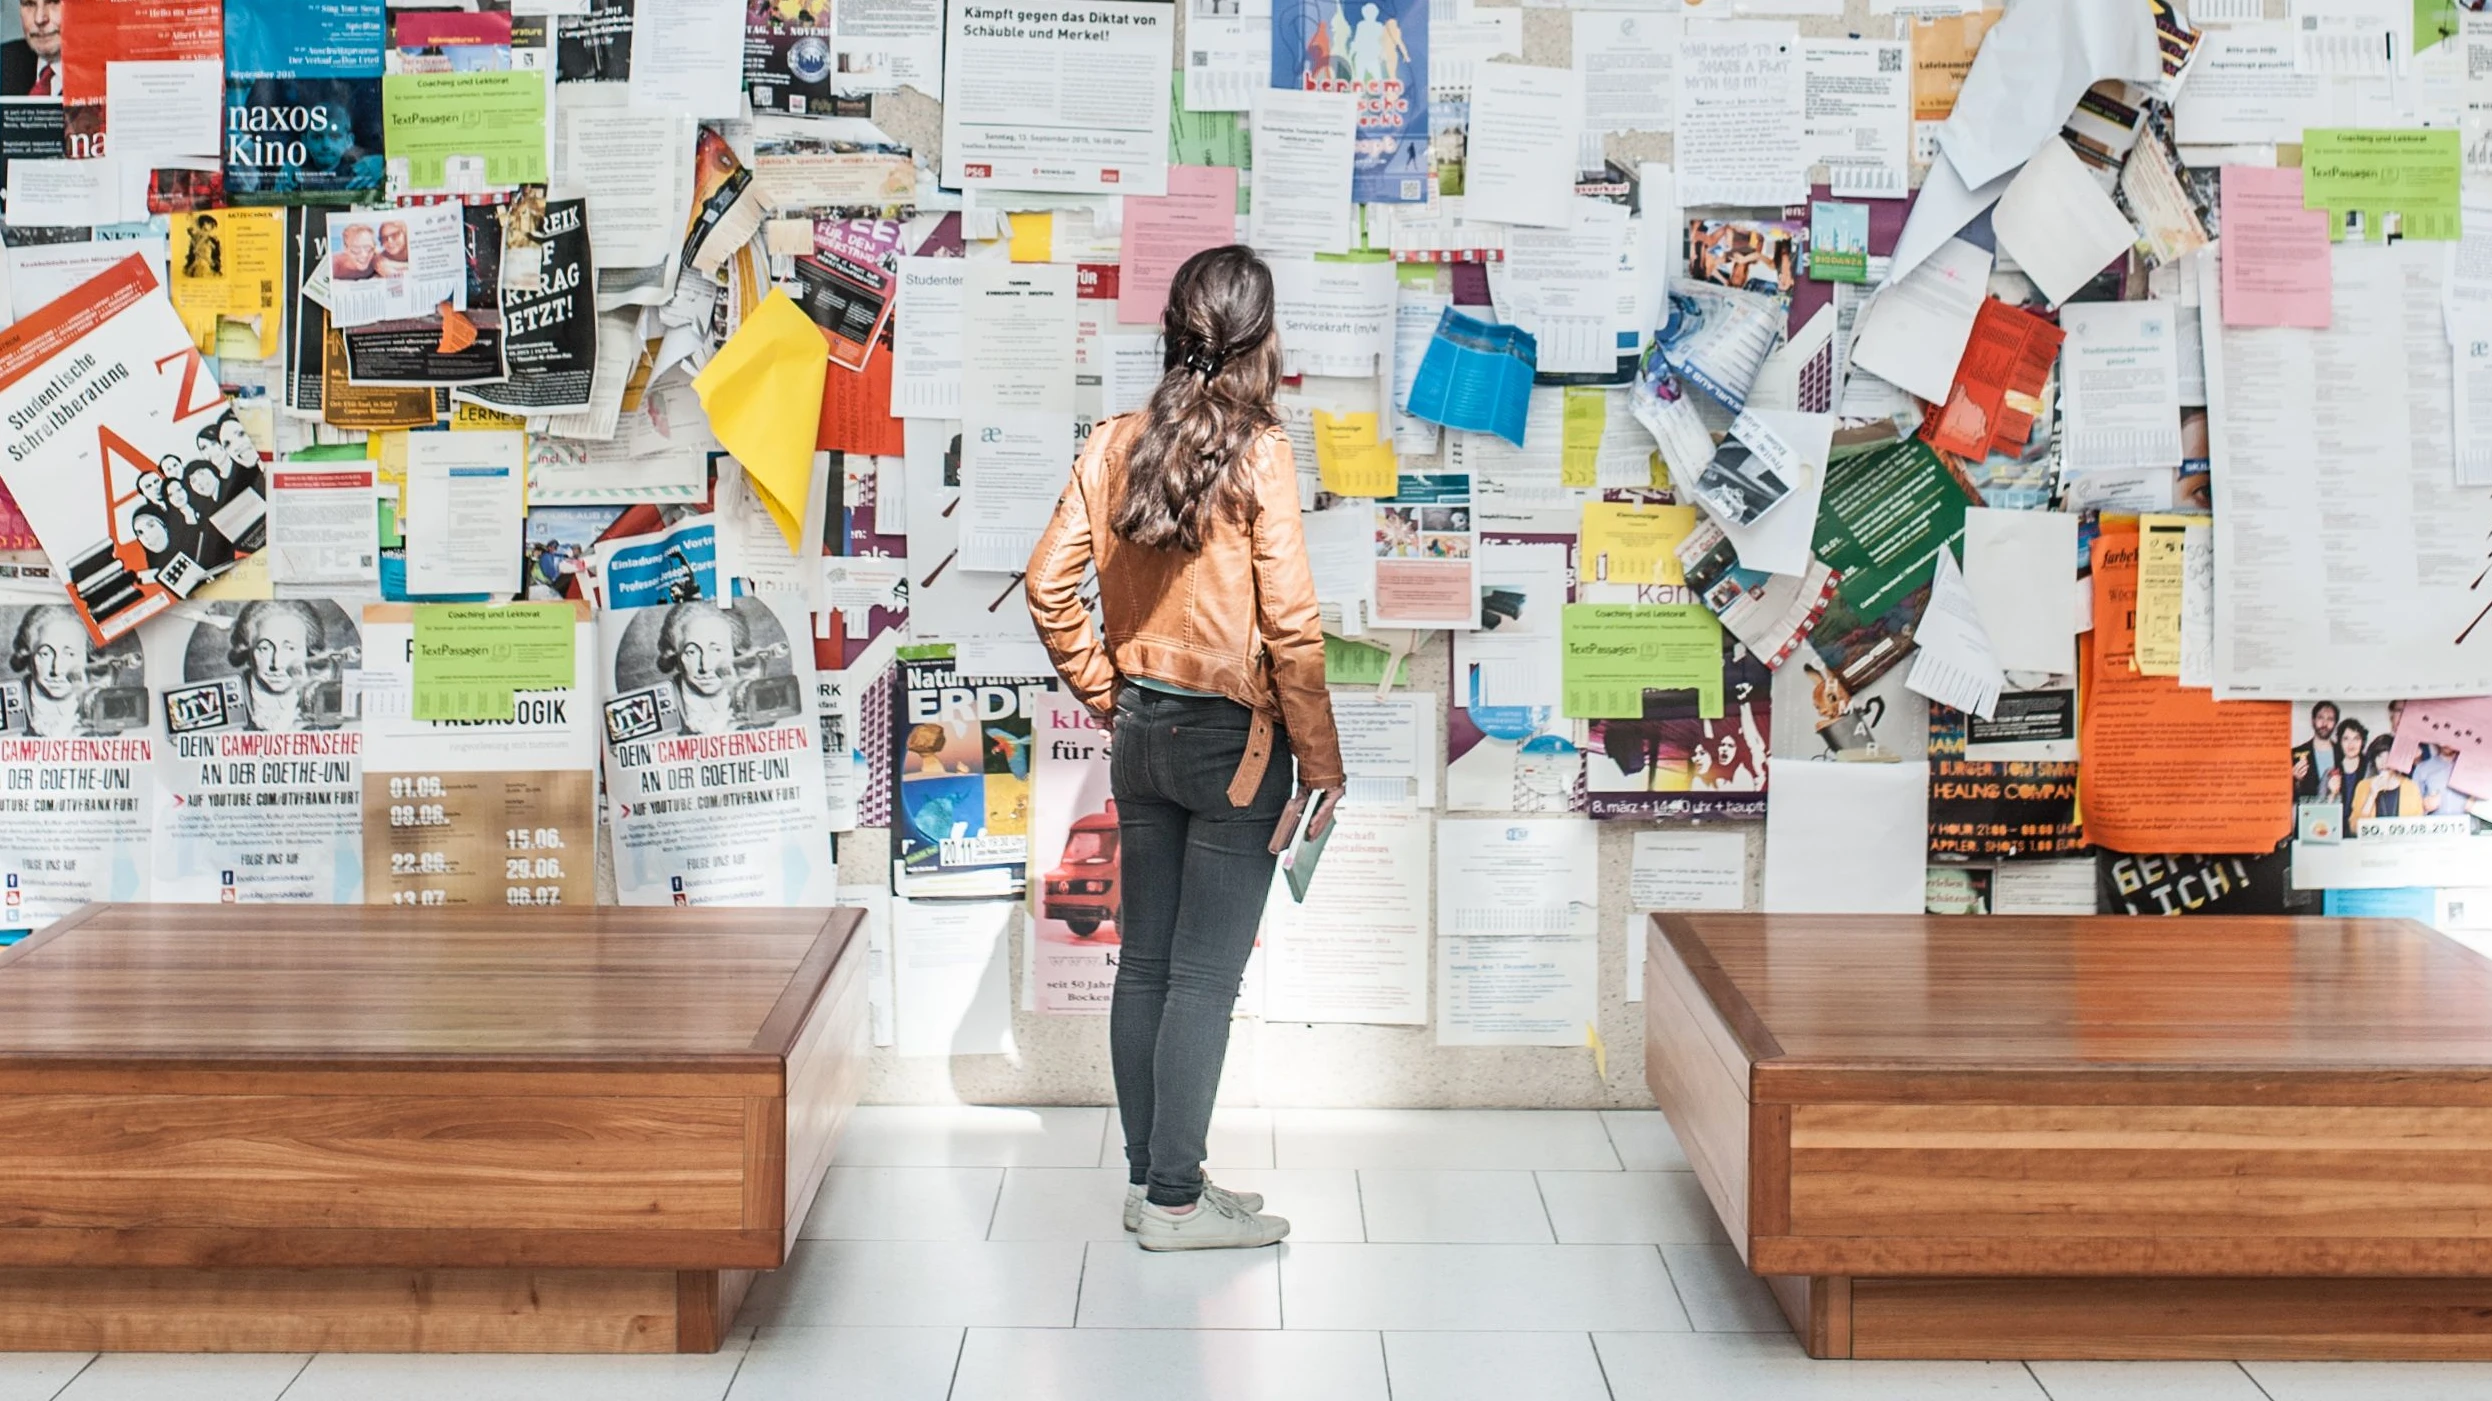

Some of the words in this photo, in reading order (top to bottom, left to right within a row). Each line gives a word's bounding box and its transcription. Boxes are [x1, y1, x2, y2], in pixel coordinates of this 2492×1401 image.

[964, 6, 1014, 21] Kämpft
[1018, 10, 1057, 24] gegen
[1061, 11, 1085, 24] das
[1088, 12, 1129, 25] Diktat
[1132, 15, 1157, 26] von
[964, 25, 1026, 39] Schäuble
[1028, 27, 1055, 40] und
[1057, 28, 1110, 42] Merkel!
[417, 77, 456, 88] Coaching
[457, 77, 473, 86] und
[475, 77, 509, 86] Lektorat
[228, 104, 339, 132] naxos.
[392, 113, 459, 128] TextPassagen
[2336, 134, 2374, 144] Coaching
[2375, 134, 2391, 142] und
[228, 136, 307, 167] Kino
[2312, 166, 2378, 180] TextPassagen
[1285, 320, 1351, 333] Servicekraft
[8, 352, 97, 430] Studentische
[7, 361, 130, 462] Schreibberatung
[611, 555, 664, 571] Einladung
[448, 610, 486, 620] Coaching
[488, 610, 504, 619] und
[506, 610, 541, 619] Lektorat
[1595, 610, 1633, 619] Coaching
[1635, 610, 1651, 618] und
[1653, 610, 1687, 618] Lektorat
[421, 643, 489, 658] TextPassagen
[1569, 643, 1638, 656] TextPassagen
[1, 739, 152, 762] CAMPUSFERNSEHEN
[180, 735, 215, 758] DEIN
[619, 741, 652, 768] DEIN
[658, 728, 808, 764] CAMPUSFERNSEHEN
[1051, 740, 1094, 760] für
[8, 768, 34, 790] DER
[40, 767, 131, 790] GOETHE-UNI
[201, 764, 222, 786] AN
[229, 762, 256, 784] DER
[262, 760, 350, 784] GOETHE-UNI
[641, 771, 662, 794] AN
[668, 766, 695, 790] DER
[701, 757, 791, 788] GOETHE-UNI
[187, 793, 203, 807] AUF
[1934, 783, 2000, 800] HEALING
[633, 802, 648, 817] AUF
[1606, 800, 1639, 815] märz
[506, 828, 565, 849] 15.06.
[506, 858, 565, 879] 29.06.
